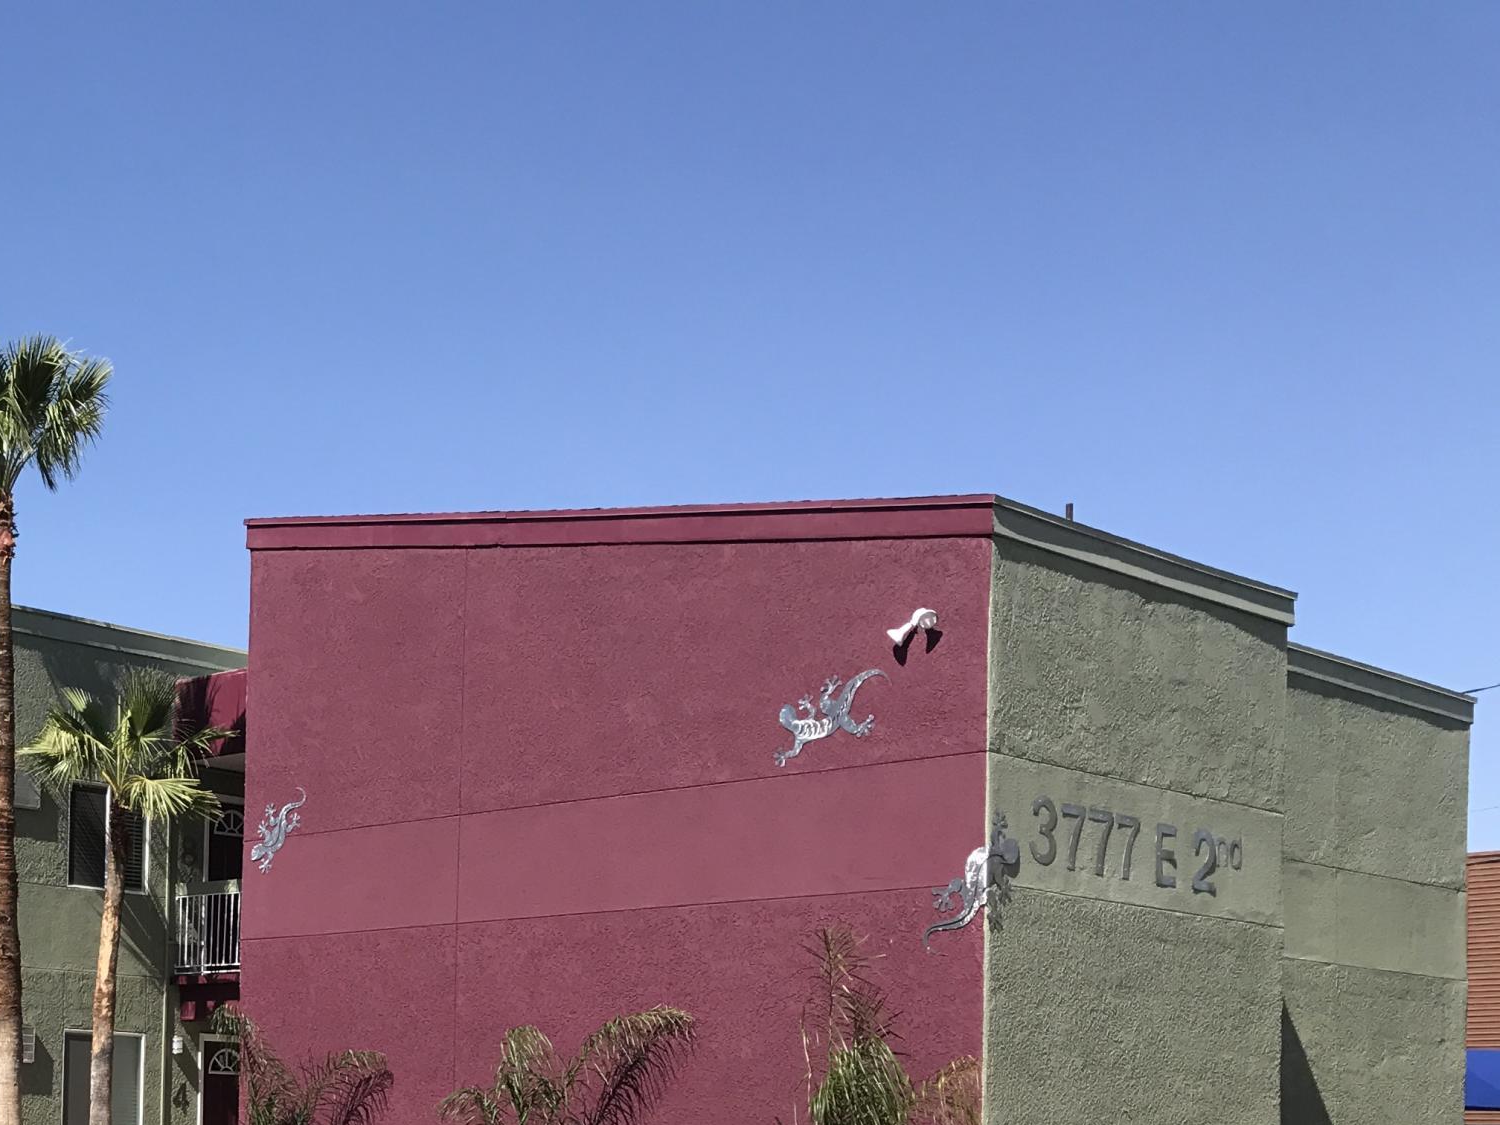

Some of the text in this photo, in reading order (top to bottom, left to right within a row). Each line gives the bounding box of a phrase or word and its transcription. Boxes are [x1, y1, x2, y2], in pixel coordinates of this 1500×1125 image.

[1029, 795, 1242, 897] 3777 E 2nd
